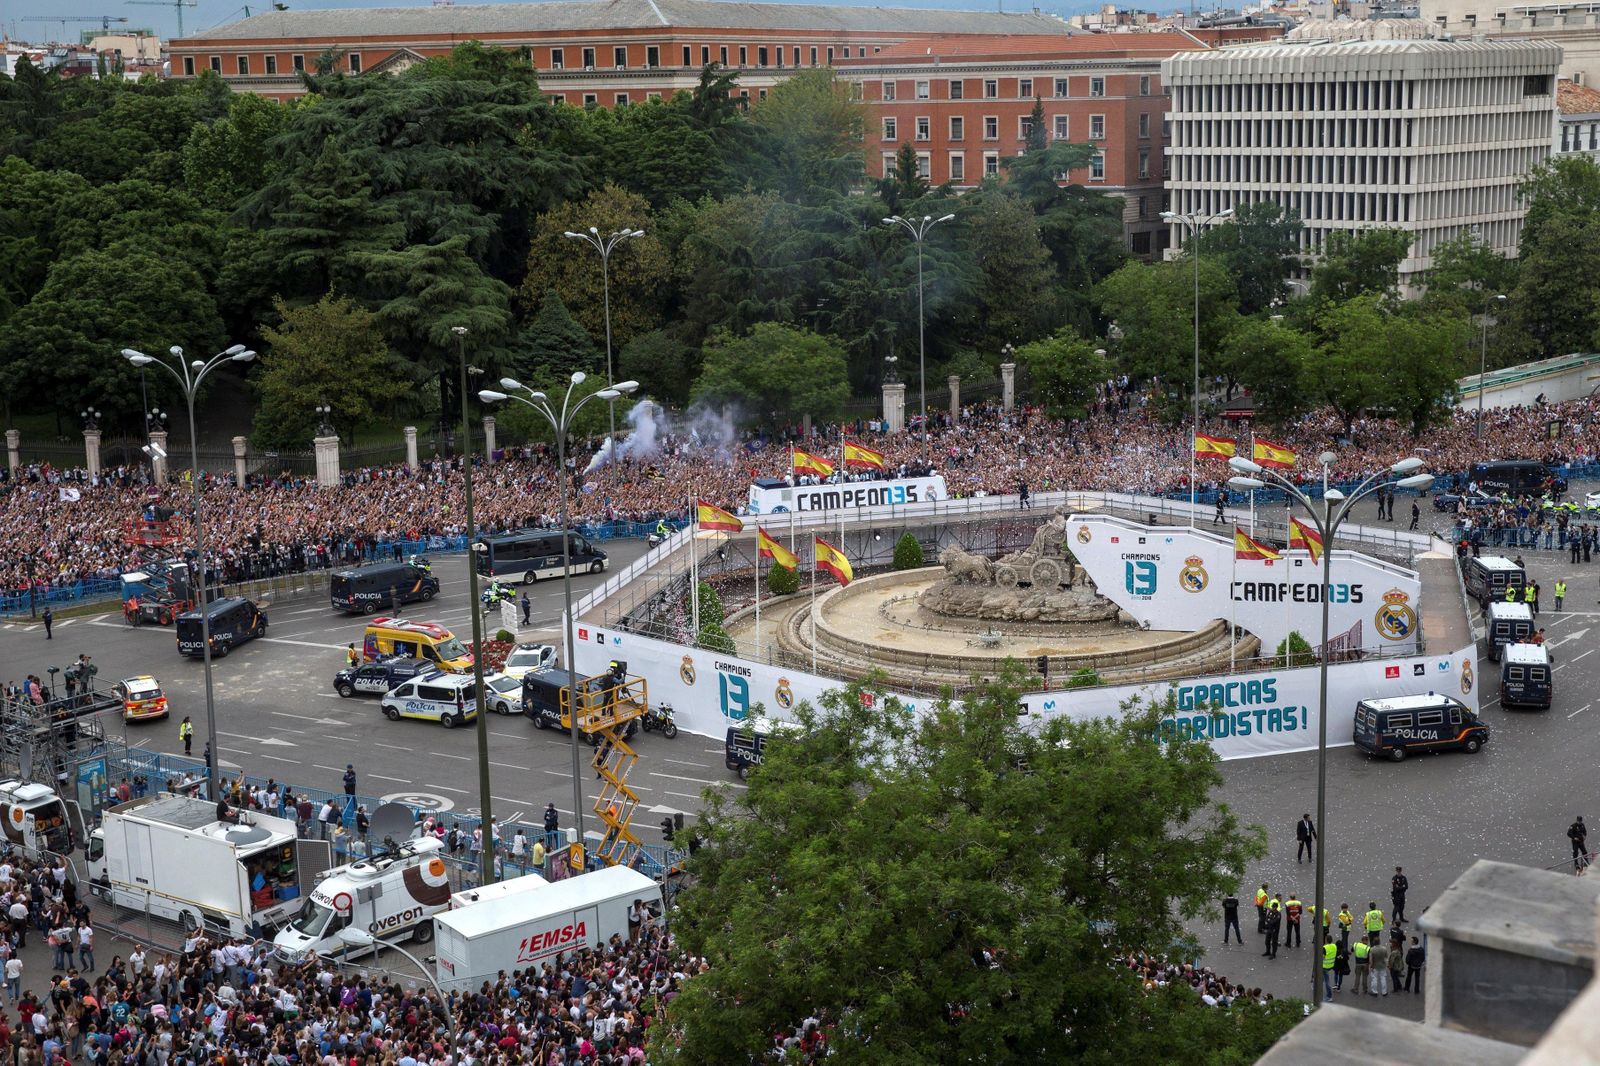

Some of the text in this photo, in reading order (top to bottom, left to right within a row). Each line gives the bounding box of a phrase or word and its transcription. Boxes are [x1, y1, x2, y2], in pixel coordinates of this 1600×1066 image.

[1484, 480, 1509, 489] POLICIA
[1121, 553, 1161, 561] CHAMPIONS
[1125, 561, 1157, 595] 13
[332, 596, 350, 604] POLICIA
[354, 592, 382, 600] POLICIA
[213, 632, 233, 641] POLICIA
[179, 641, 204, 649] POLICI
[714, 661, 752, 678] CHAMPIONS
[718, 671, 750, 721] 13
[1395, 728, 1438, 741] POLICIA
[368, 905, 424, 934] overon
[529, 921, 586, 953] EMSA
[115, 1008, 126, 1018] 22
